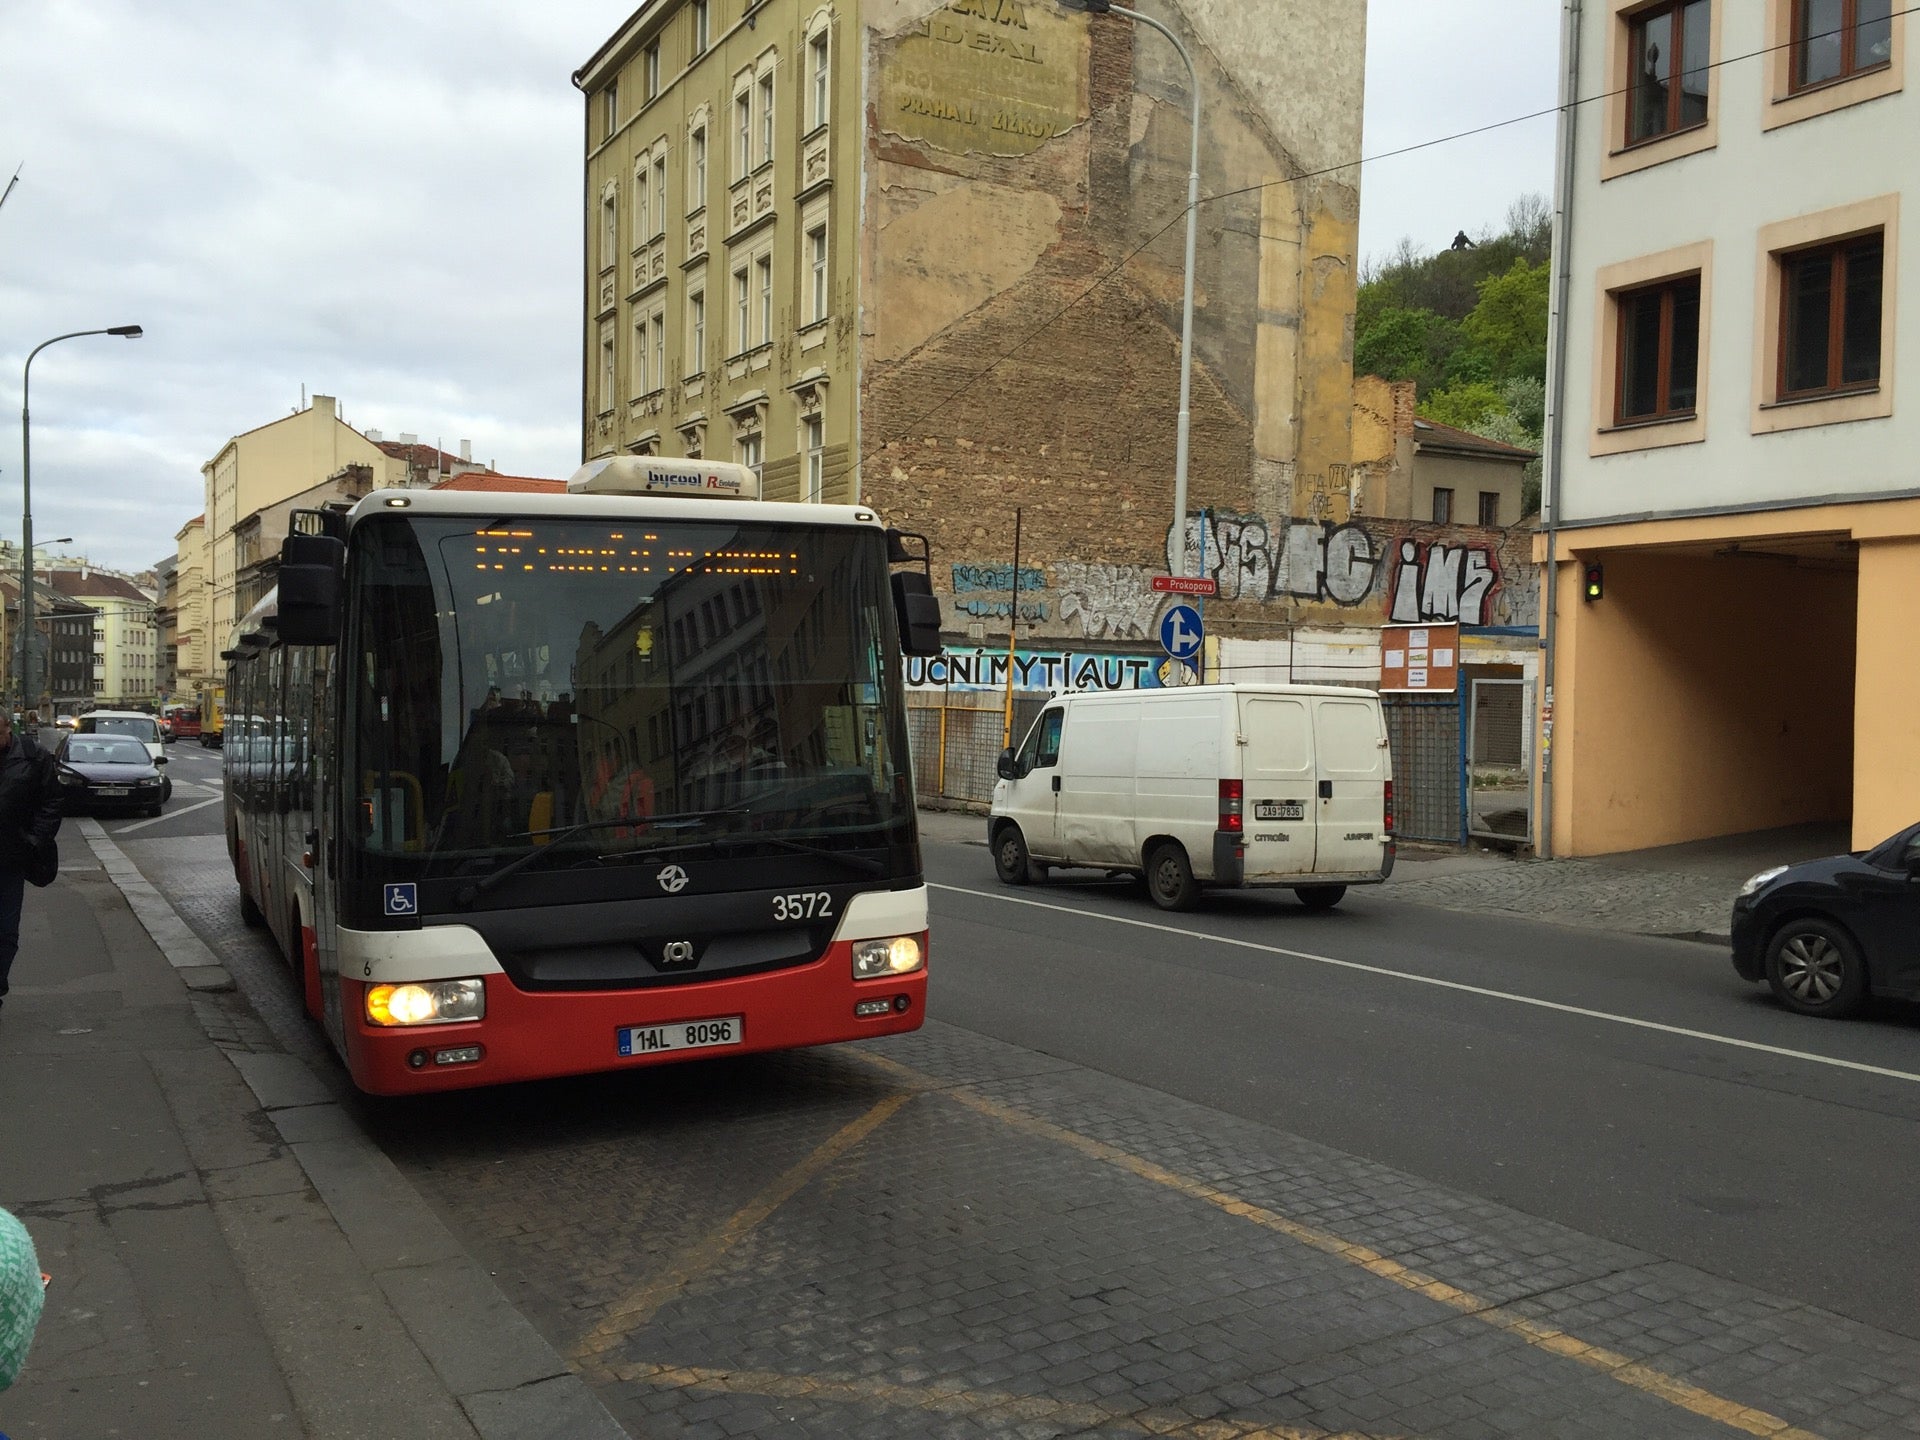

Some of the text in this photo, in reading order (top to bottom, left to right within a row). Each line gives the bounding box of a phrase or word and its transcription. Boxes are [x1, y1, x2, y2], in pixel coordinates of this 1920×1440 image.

[900, 97, 961, 122] PRAHA
[648, 470, 702, 488] bycool
[1169, 579, 1213, 592] Prokopova
[772, 891, 833, 921] 3572
[363, 960, 372, 977] 6
[637, 1028, 671, 1051] 1AL
[685, 1021, 732, 1045] 8096
